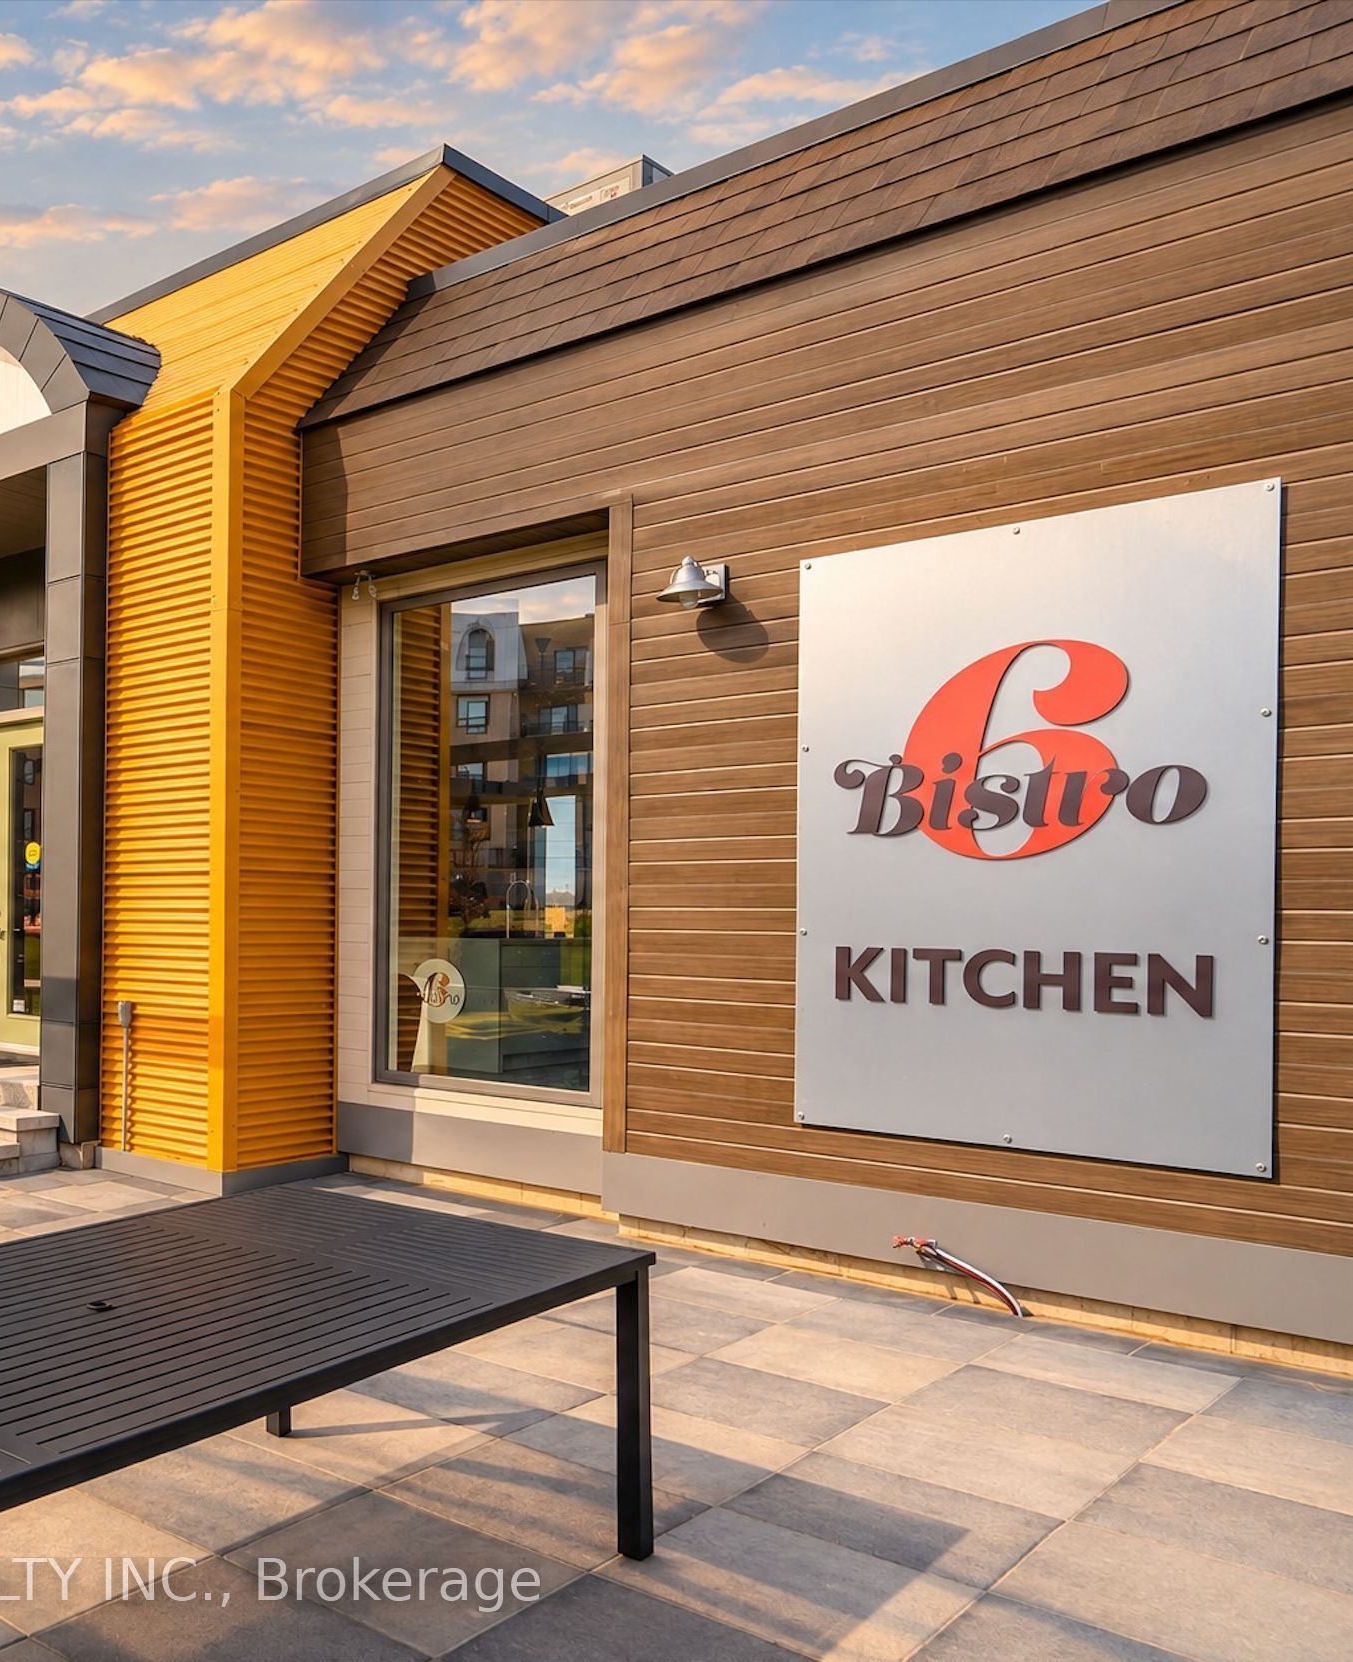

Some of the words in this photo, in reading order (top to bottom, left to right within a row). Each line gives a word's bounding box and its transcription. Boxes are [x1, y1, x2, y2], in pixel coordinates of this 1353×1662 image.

[901, 639, 1129, 860] 6
[834, 751, 1209, 838] Bistro
[834, 946, 1216, 1019] KITCHEN
